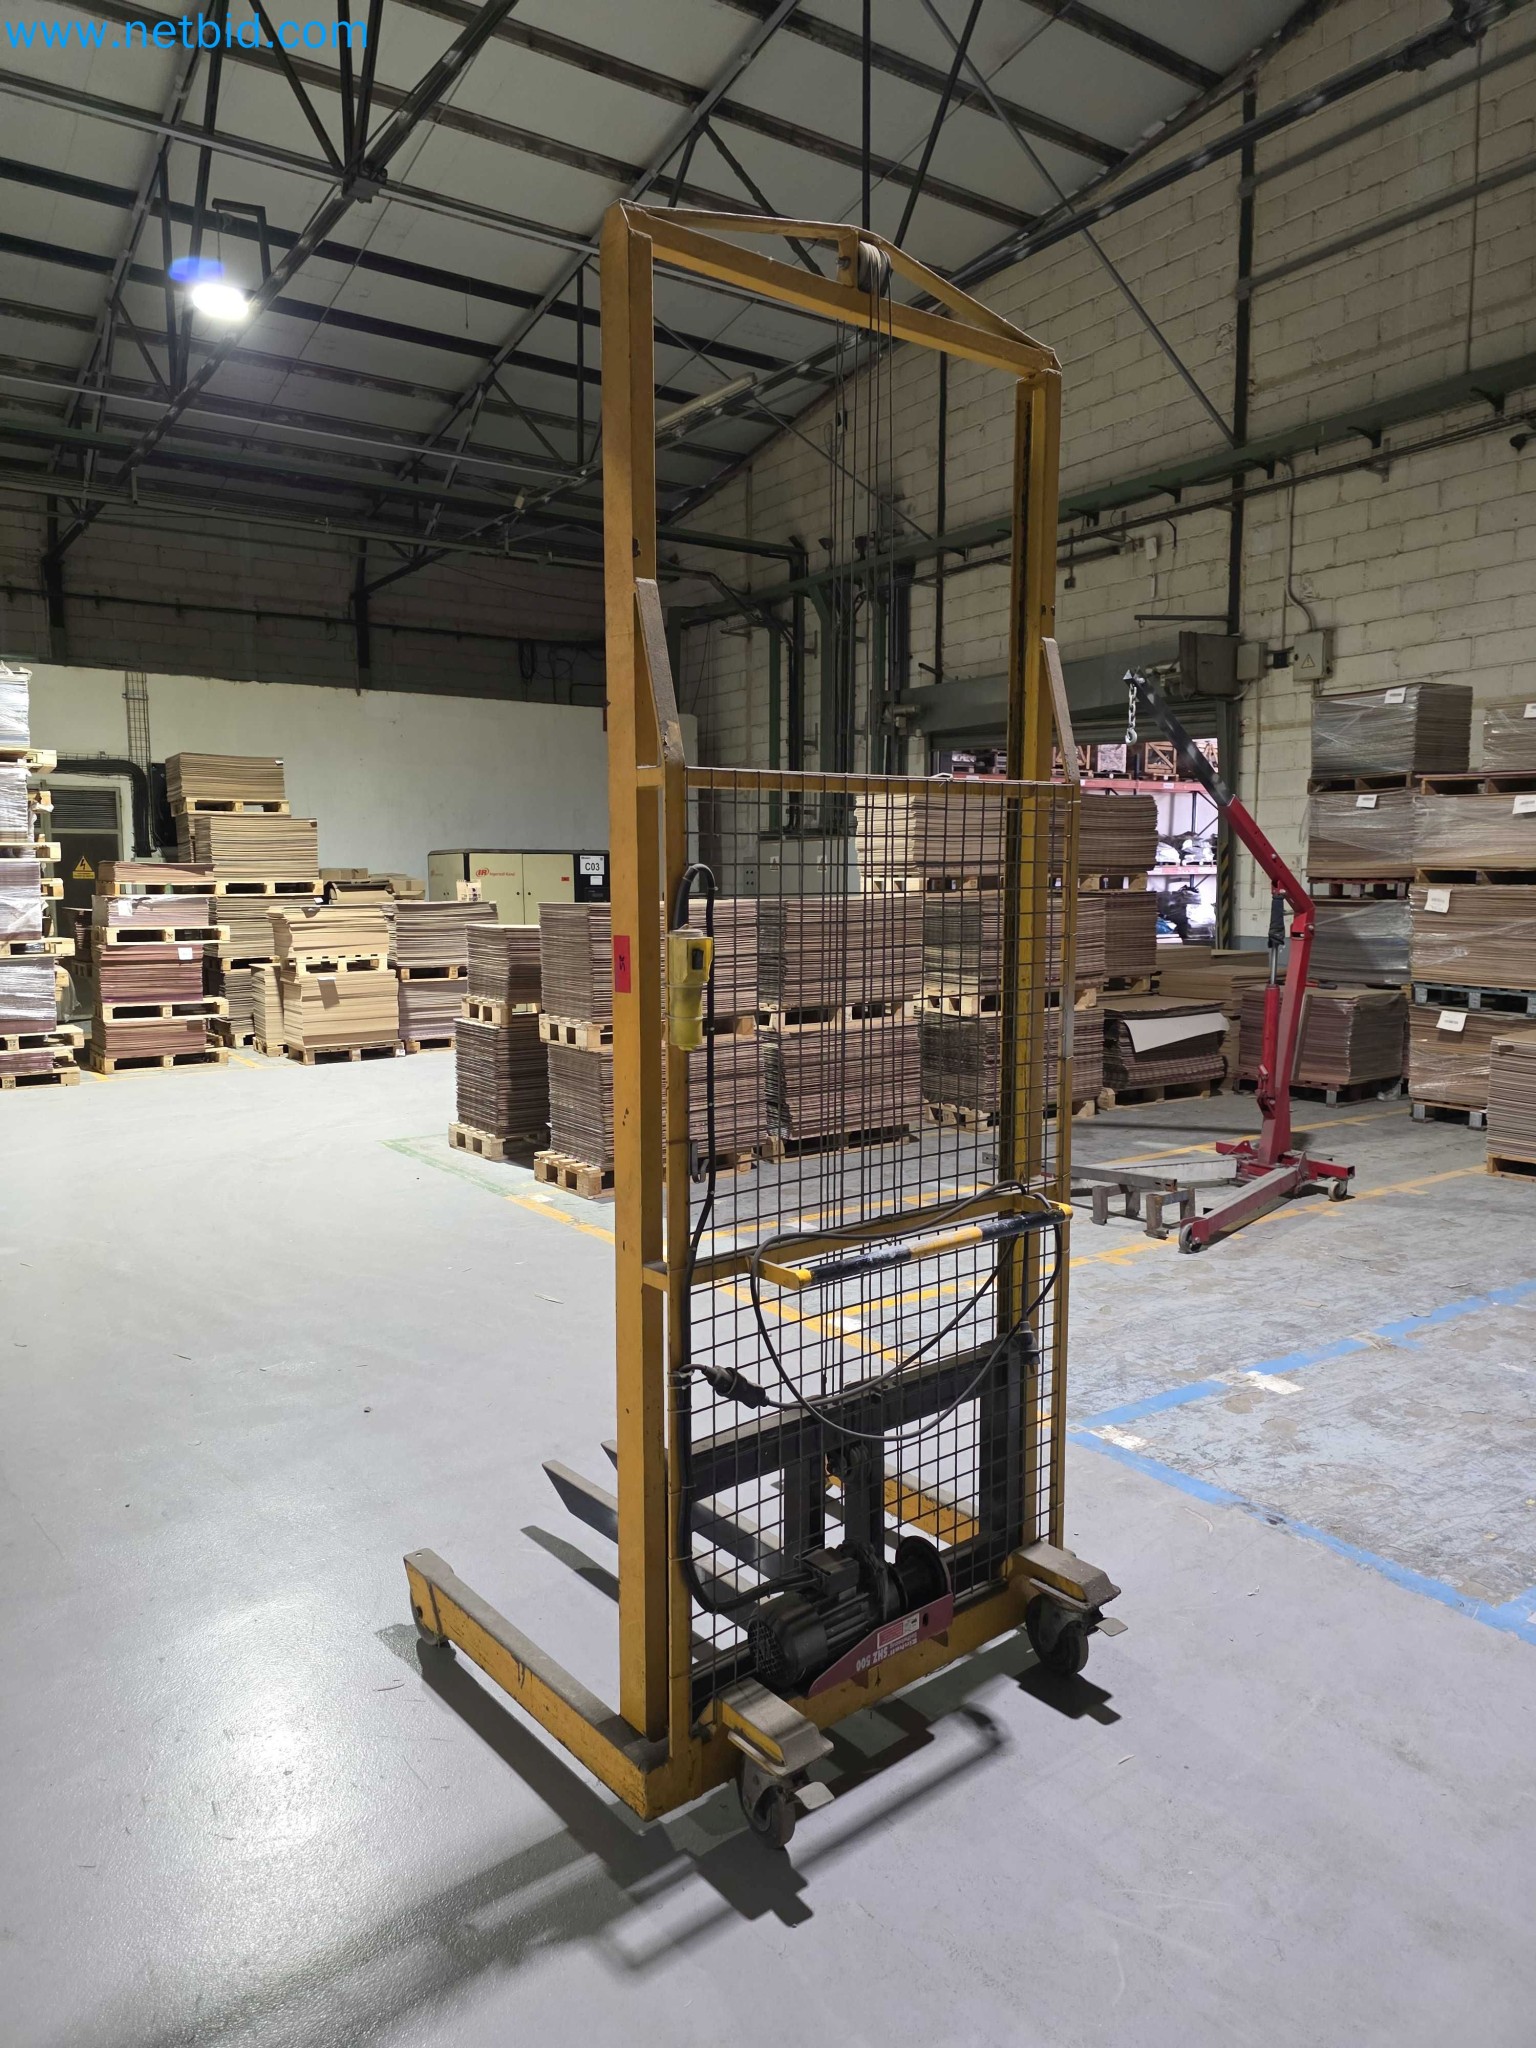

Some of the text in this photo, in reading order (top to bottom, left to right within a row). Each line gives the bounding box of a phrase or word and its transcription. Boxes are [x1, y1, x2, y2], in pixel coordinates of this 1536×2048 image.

[585, 862, 600, 871] C03
[856, 1655, 871, 1671] 500
[872, 1647, 888, 1663] SHZ
